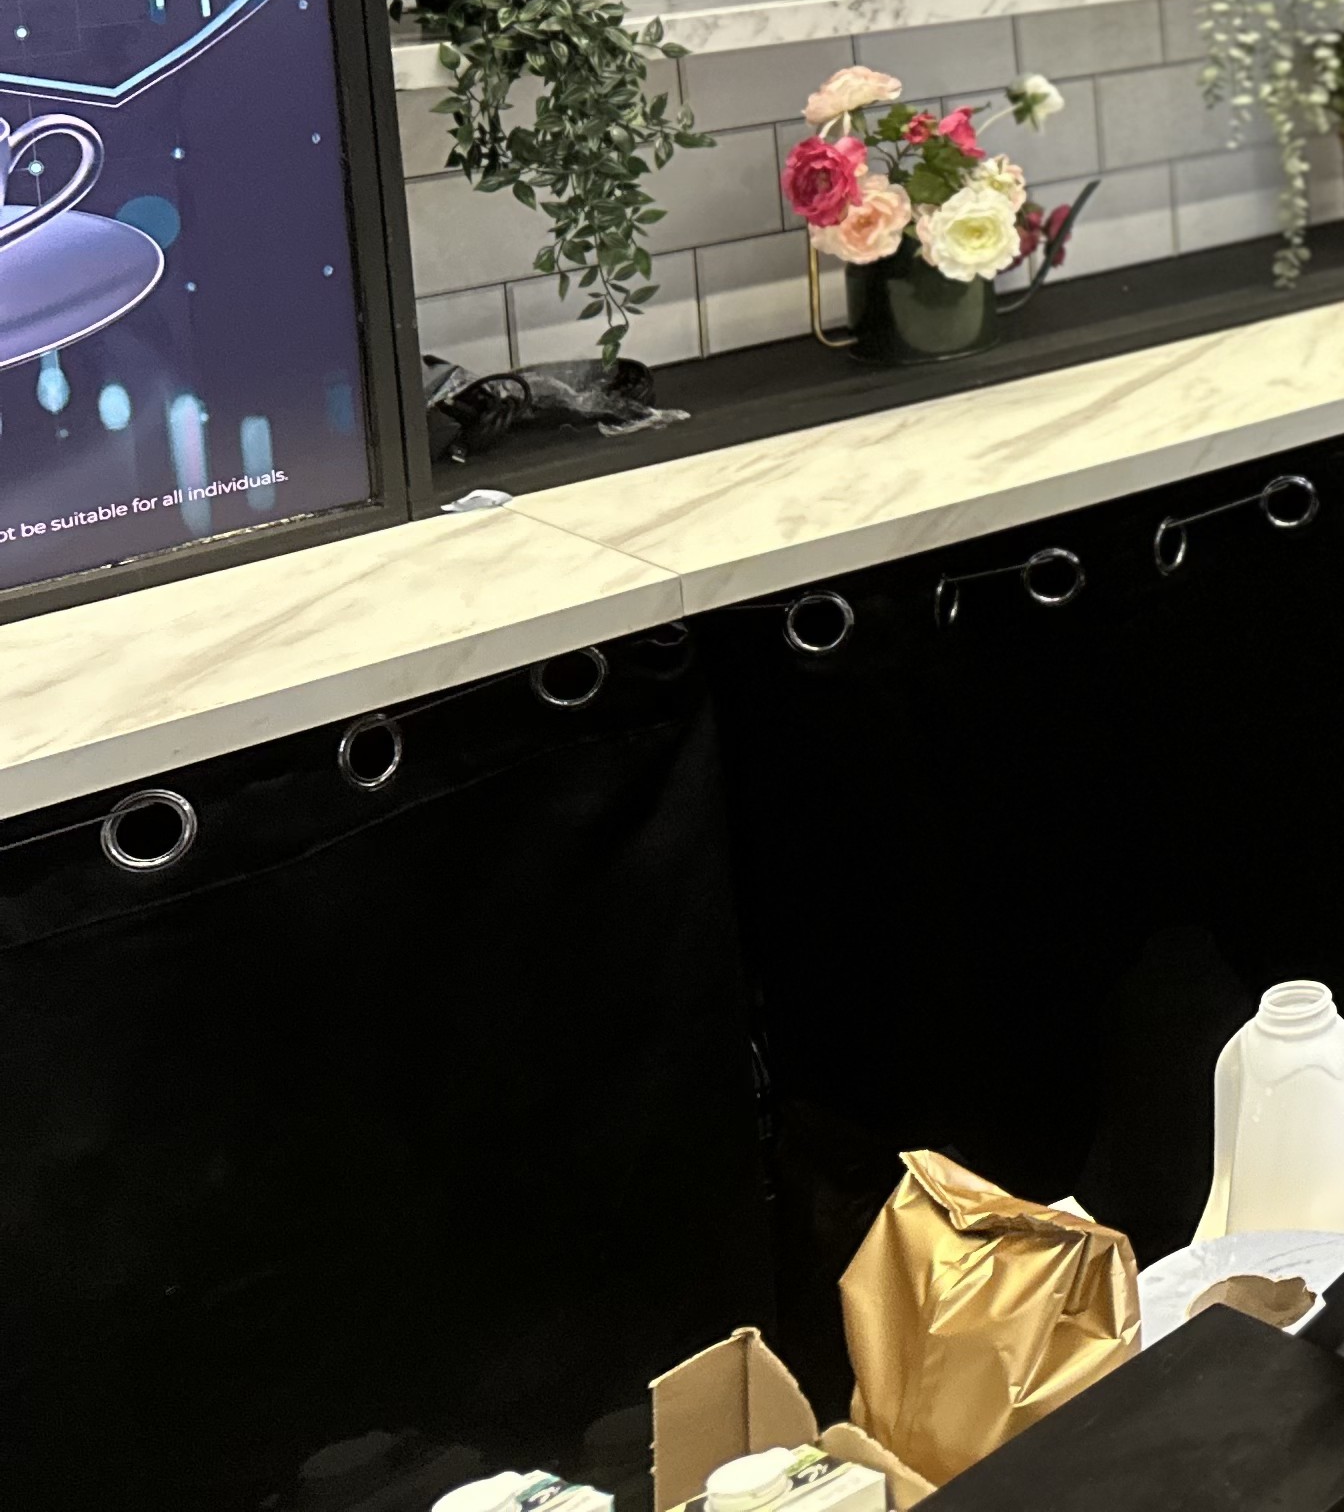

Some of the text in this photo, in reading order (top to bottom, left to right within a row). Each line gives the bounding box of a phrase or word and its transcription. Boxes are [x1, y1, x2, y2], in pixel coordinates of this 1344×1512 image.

[20, 522, 47, 538] be
[51, 501, 128, 532] suitable
[132, 497, 158, 514] for
[162, 489, 182, 507] all
[188, 468, 289, 501] individuals.
